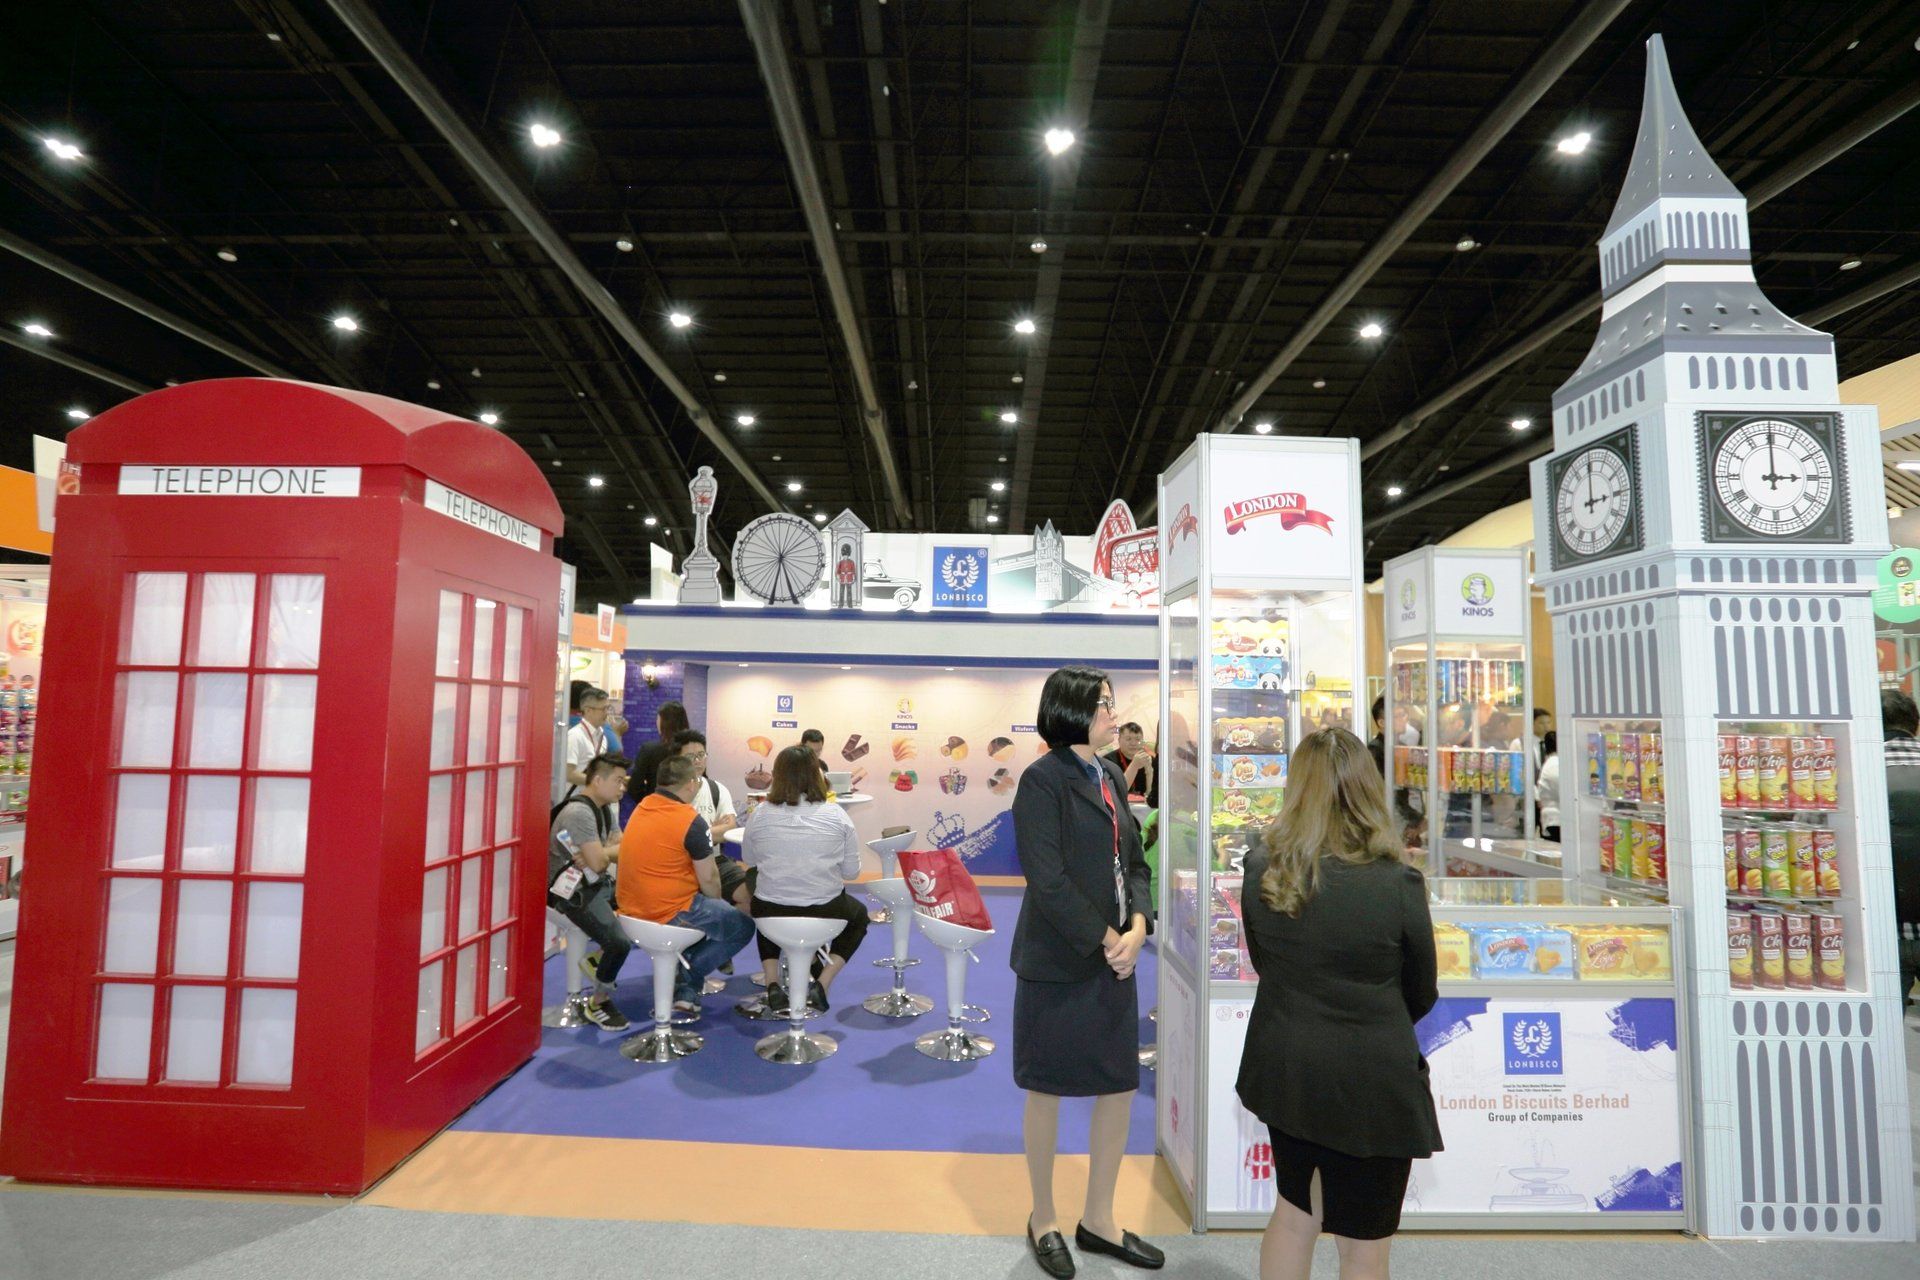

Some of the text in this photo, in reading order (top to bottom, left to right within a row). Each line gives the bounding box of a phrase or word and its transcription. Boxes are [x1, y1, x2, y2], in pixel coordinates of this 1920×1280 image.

[153, 468, 327, 494] TELEPHONE
[445, 490, 528, 544] TELEPHONE
[936, 594, 984, 602] LONBISCO
[1462, 607, 1495, 617] KINOS
[1509, 1060, 1559, 1069] LONBISCO
[1440, 1093, 1629, 1110] London Biscuits Berhad
[1488, 1111, 1583, 1124] Group of Companies
